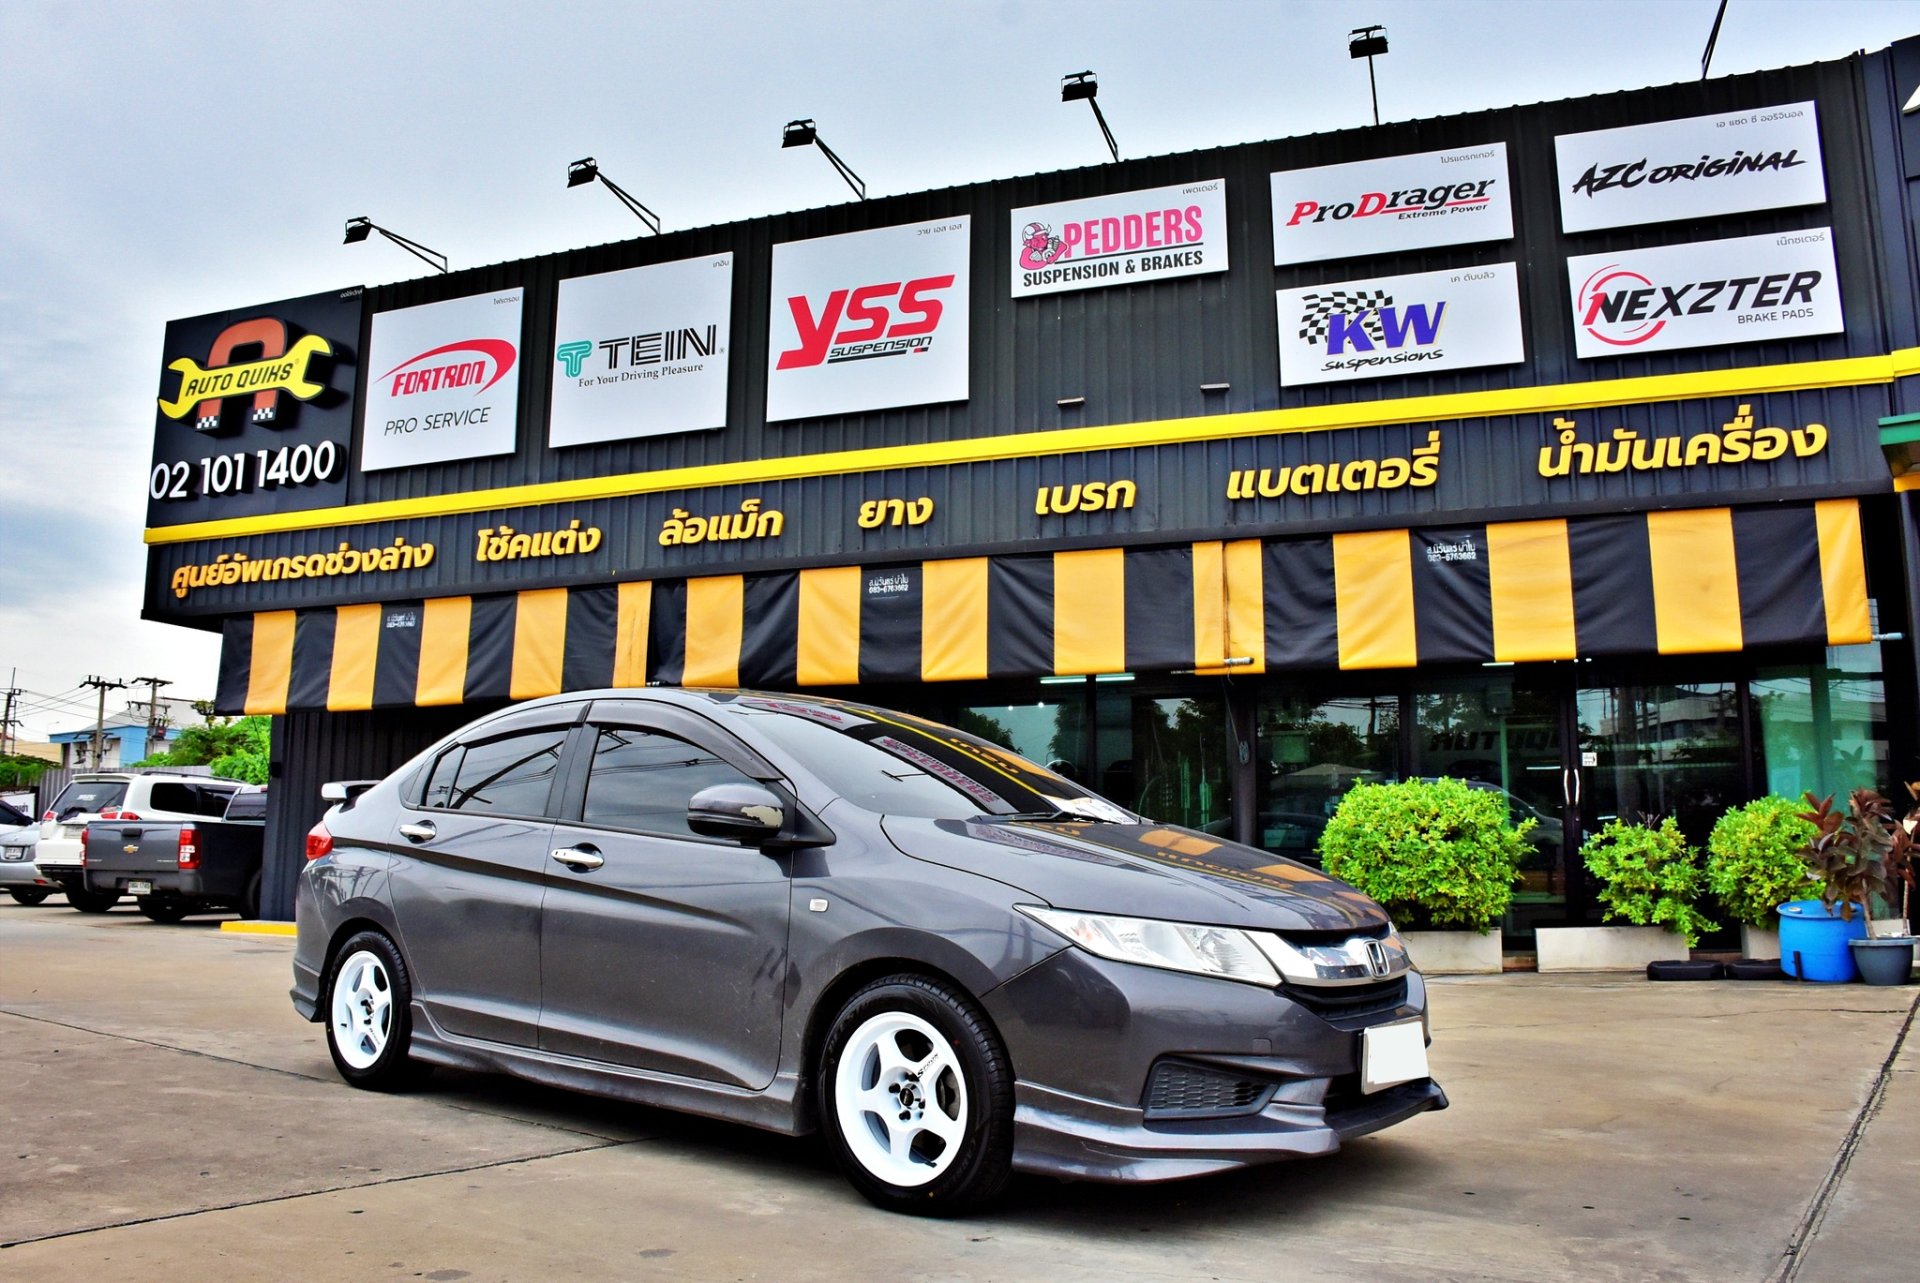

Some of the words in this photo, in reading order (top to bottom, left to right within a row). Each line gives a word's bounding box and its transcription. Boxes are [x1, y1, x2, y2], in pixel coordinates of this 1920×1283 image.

[1571, 157, 1648, 199] AZC
[1286, 176, 1496, 228] ProDrager
[1398, 207, 1447, 221] Extreme
[1450, 203, 1489, 216] Power
[1063, 205, 1204, 258] PEDDERS
[1023, 262, 1121, 288] SUSPENSION
[1124, 259, 1137, 273] &
[1141, 250, 1204, 272] BRAKES
[1582, 270, 1823, 326] NEXZTER
[1737, 311, 1777, 325] BRAKE
[1782, 307, 1814, 320] PADS
[776, 274, 956, 370] YSS
[1327, 300, 1447, 356] KW
[599, 325, 717, 370] TEIN
[829, 336, 933, 357] SUSPENSION
[1321, 348, 1445, 372] suspensions
[185, 373, 233, 397] AUTO
[235, 363, 295, 389] QUIKS
[391, 360, 486, 398] FORTRON
[578, 378, 594, 388] For
[597, 375, 619, 385] Your
[621, 369, 659, 383] Driving
[662, 363, 704, 376] Pleasure
[384, 419, 417, 437] PRO
[424, 407, 492, 430] SERVICE
[150, 461, 191, 501] 02
[201, 451, 245, 495] 101
[257, 439, 336, 489] 1400
[170, 536, 435, 600] ศูนย์อัพเกรดช่วงล่าง
[475, 520, 602, 562] โช้คแต่ง
[658, 498, 785, 547] ล้อแม็ก
[857, 495, 935, 529] ยาง
[1034, 479, 1137, 516] เบรก
[1225, 430, 1440, 500] แบตเตอรี่
[1537, 404, 1829, 480] น้ำมันเครื่อง
